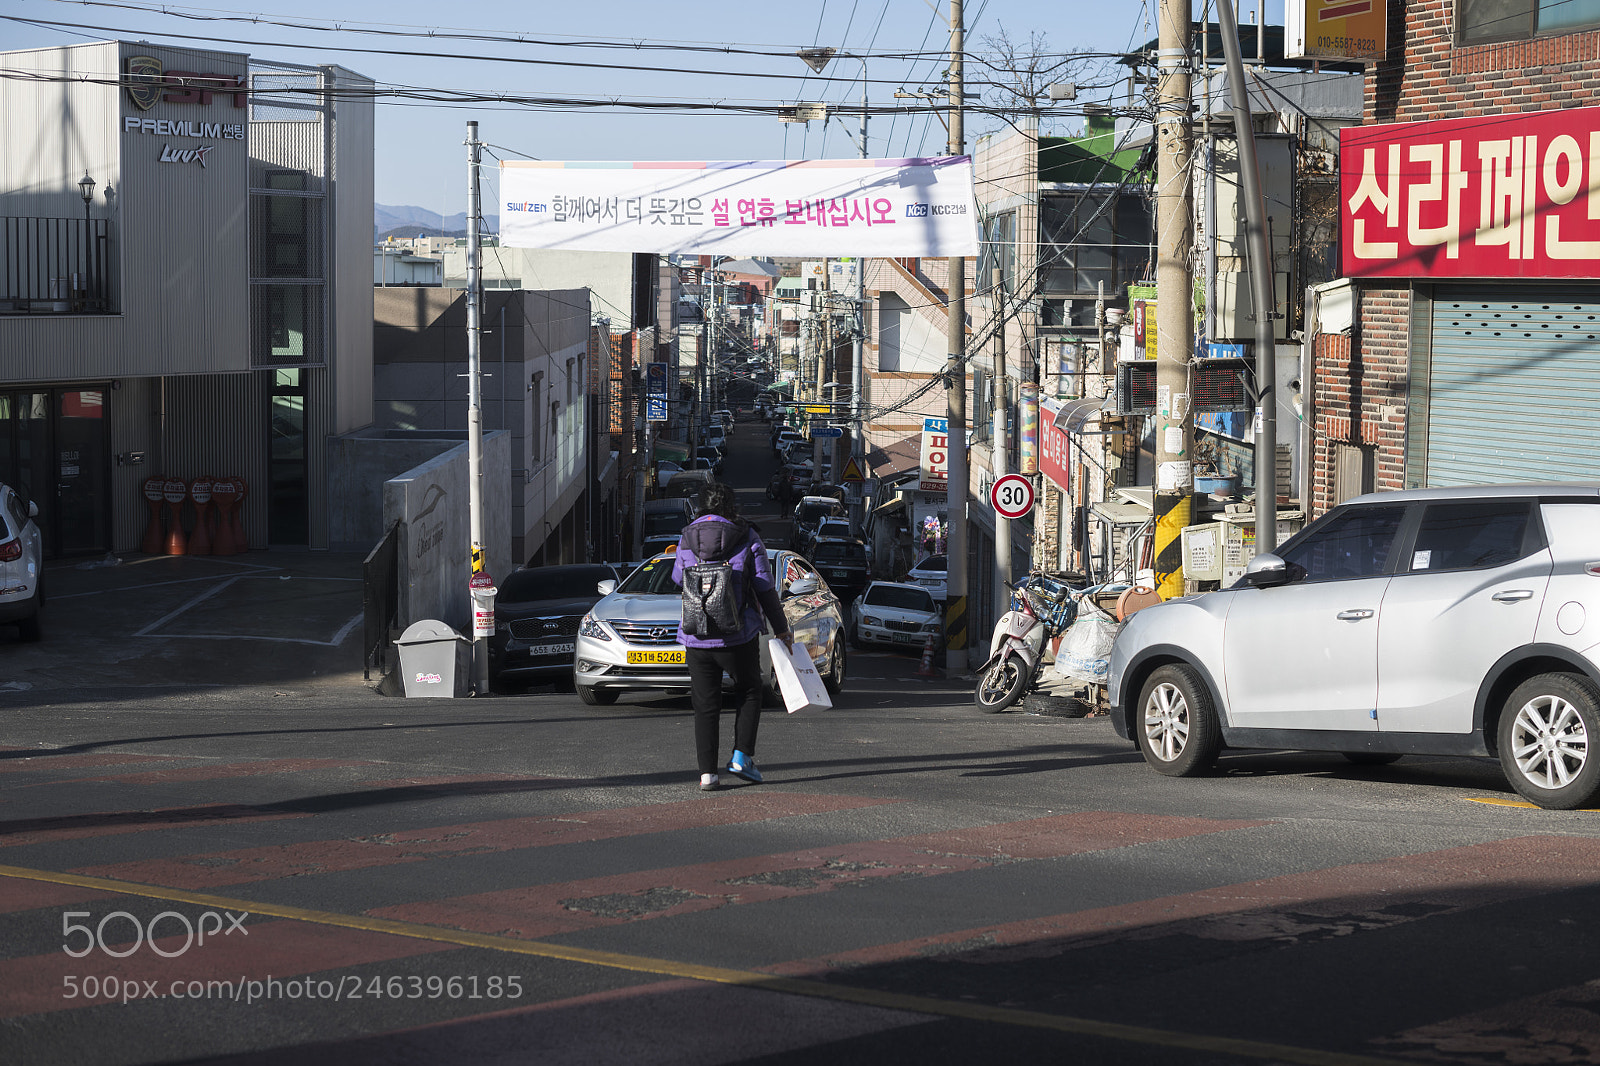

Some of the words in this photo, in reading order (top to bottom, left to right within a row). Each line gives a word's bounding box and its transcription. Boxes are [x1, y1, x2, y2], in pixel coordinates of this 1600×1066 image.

[1317, 36, 1375, 51] 010-5587-8223
[124, 116, 221, 139] PREMIUM
[222, 124, 245, 140] 썬팅
[552, 195, 619, 225] 함께여서
[626, 196, 642, 225] 더
[649, 197, 704, 226] 뜻깊은
[710, 197, 730, 227] 설
[736, 197, 778, 227] 연휴
[784, 197, 896, 227] 보내십시오
[907, 203, 929, 217] KCC
[931, 203, 967, 216] KCC건설
[1002, 486, 1024, 506] 30
[657, 652, 682, 663] 5248
